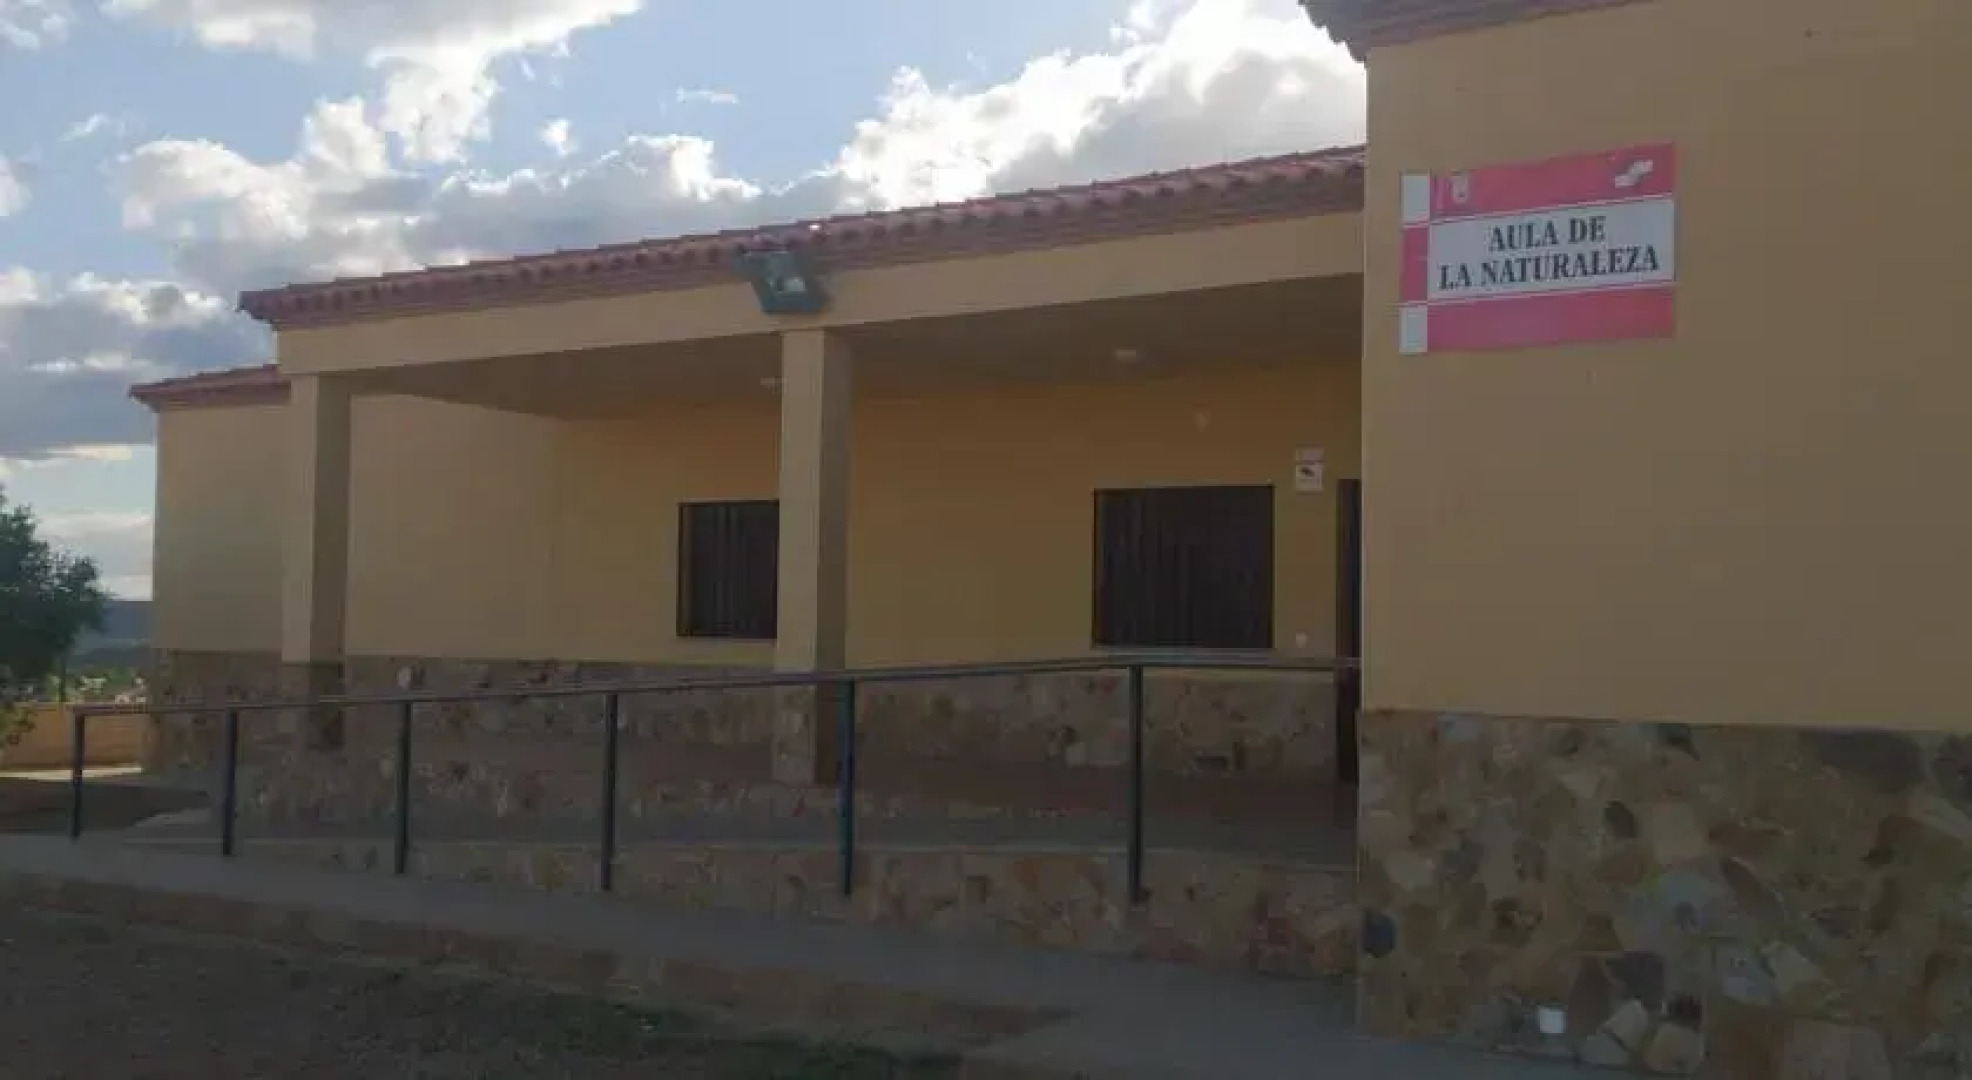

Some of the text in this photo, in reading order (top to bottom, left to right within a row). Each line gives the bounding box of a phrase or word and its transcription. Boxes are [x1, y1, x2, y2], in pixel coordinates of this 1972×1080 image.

[1489, 216, 1606, 251] AULA DE
[1439, 245, 1659, 290] LA NATURALEZA
